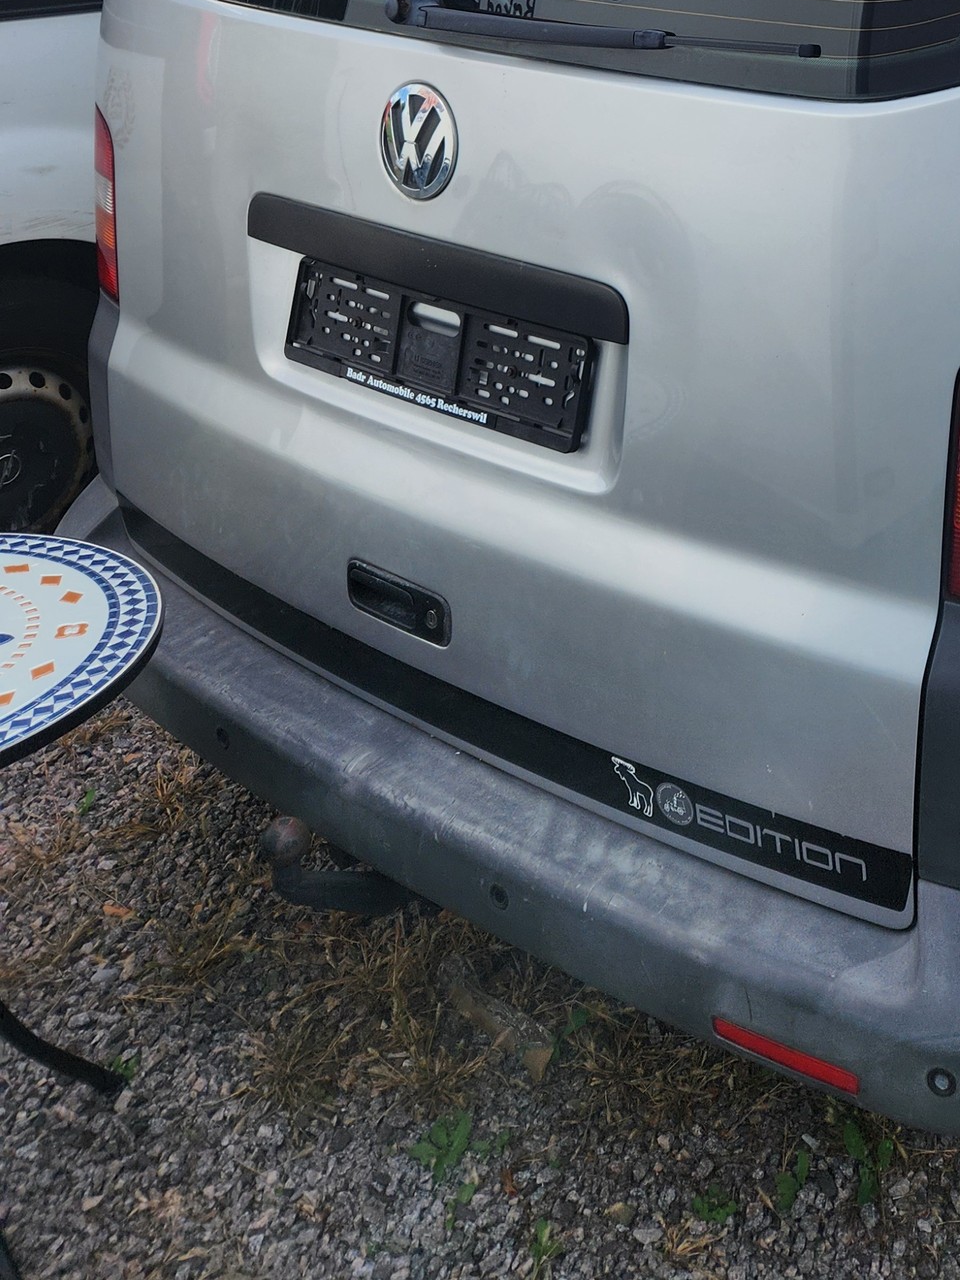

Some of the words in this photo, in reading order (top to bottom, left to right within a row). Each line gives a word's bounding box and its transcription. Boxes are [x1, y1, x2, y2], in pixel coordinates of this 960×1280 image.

[380, 80, 459, 201] VW
[346, 367, 367, 383] Badr
[366, 375, 415, 400] Automobile
[415, 393, 437, 408] 4565
[437, 398, 488, 424] Recherswil
